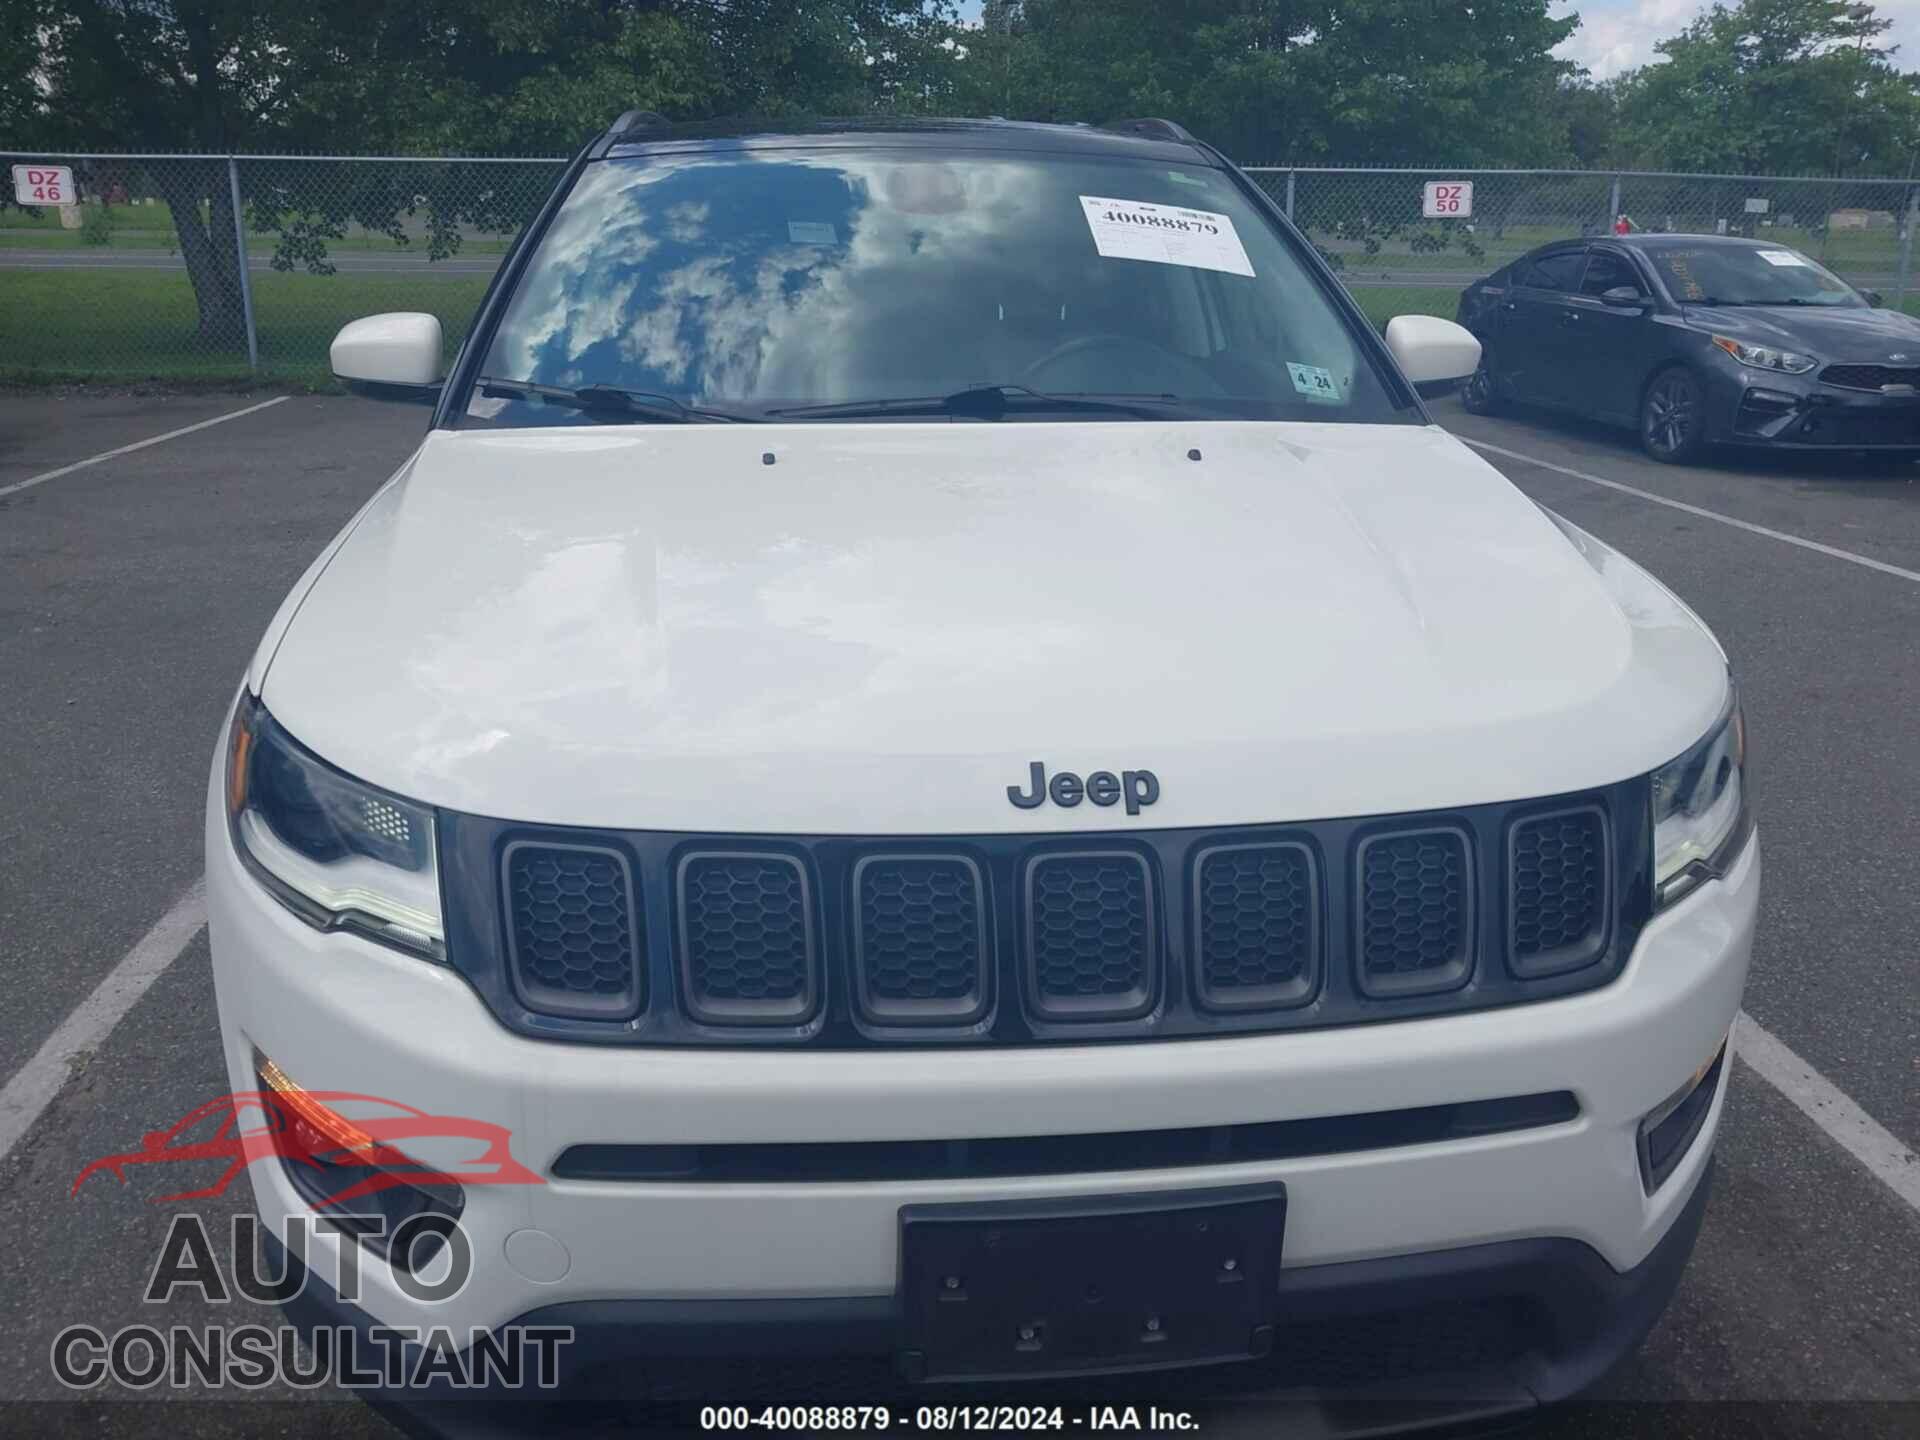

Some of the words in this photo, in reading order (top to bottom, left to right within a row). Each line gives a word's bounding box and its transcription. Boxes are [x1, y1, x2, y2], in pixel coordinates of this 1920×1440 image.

[27, 170, 60, 185] DZ
[32, 186, 61, 201] 46
[1436, 186, 1462, 200] DZ
[1436, 199, 1460, 213] 50
[1102, 210, 1219, 236] 40088879
[1314, 375, 1331, 389] 24
[1006, 761, 1160, 816] Jeep
